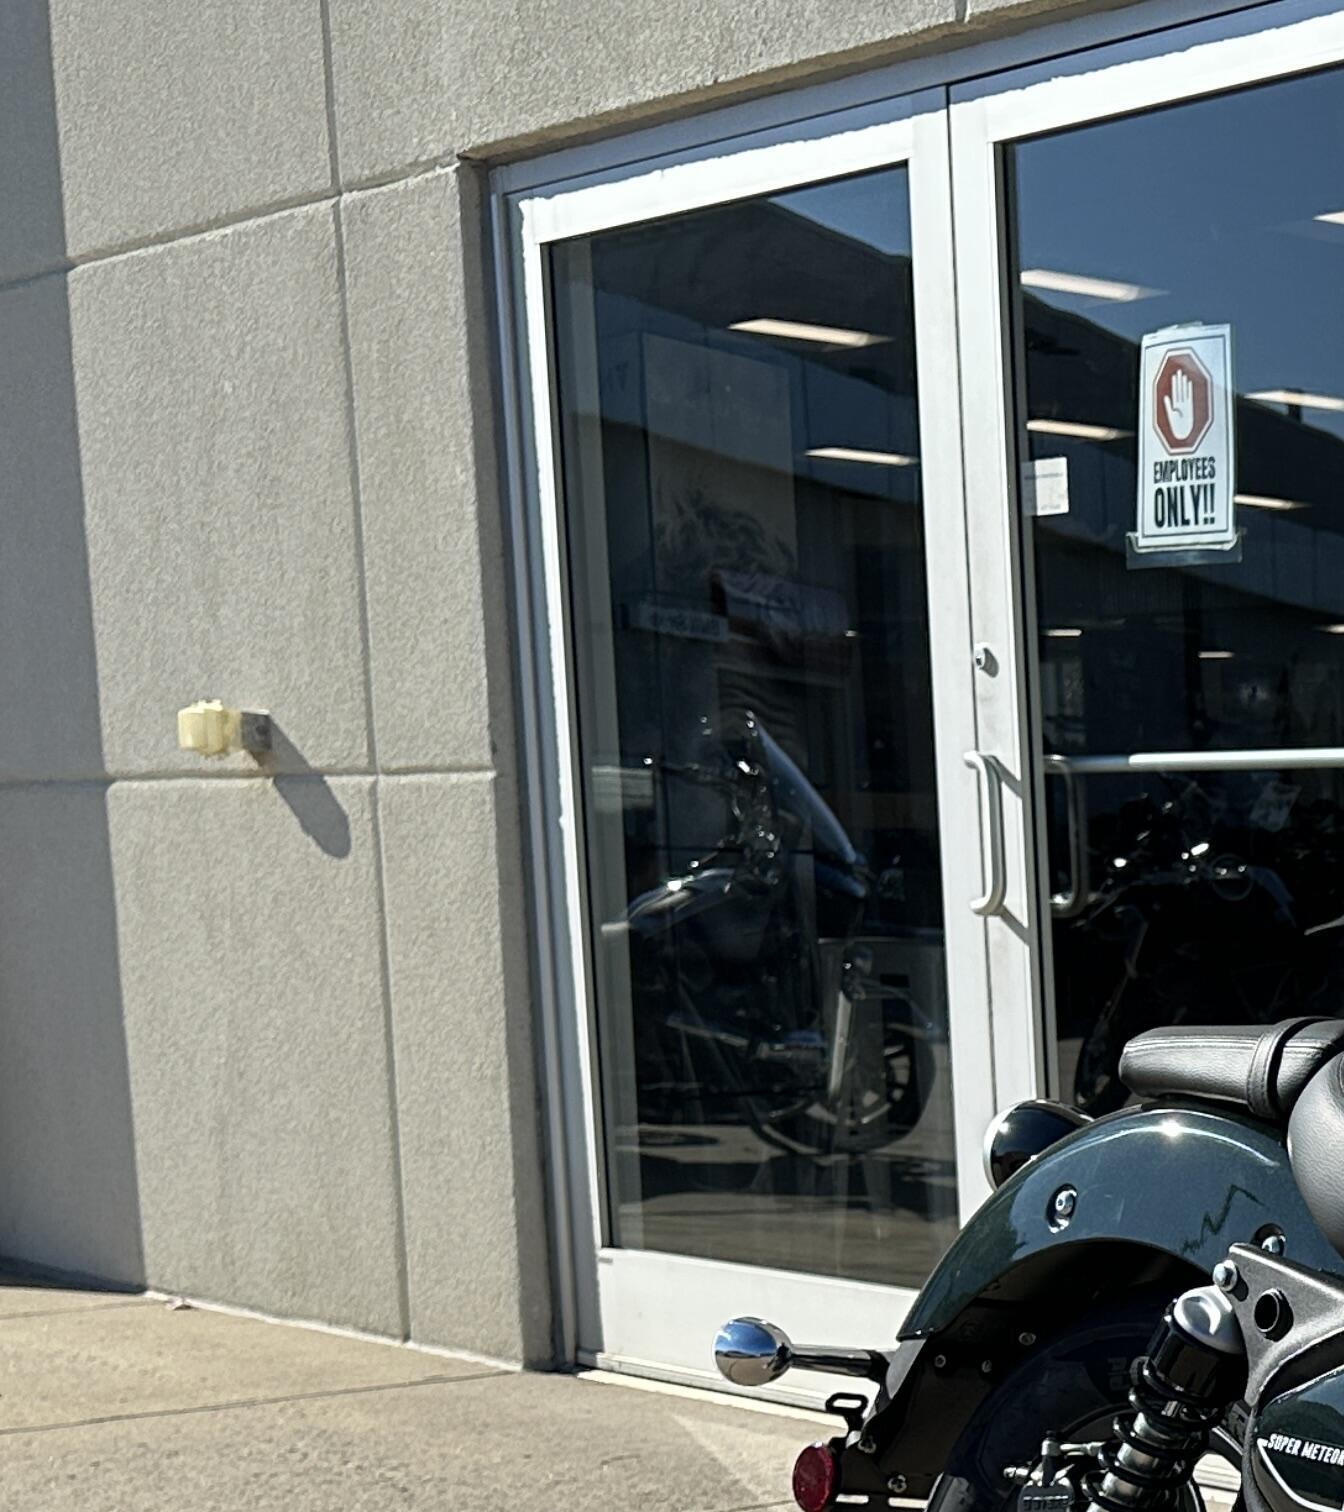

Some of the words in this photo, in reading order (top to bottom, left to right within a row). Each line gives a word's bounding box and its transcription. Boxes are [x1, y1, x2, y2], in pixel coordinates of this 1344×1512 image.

[1153, 456, 1216, 484] EMPLOYEES
[1153, 483, 1216, 528] ONLY!!
[1267, 1433, 1302, 1456] SUPER
